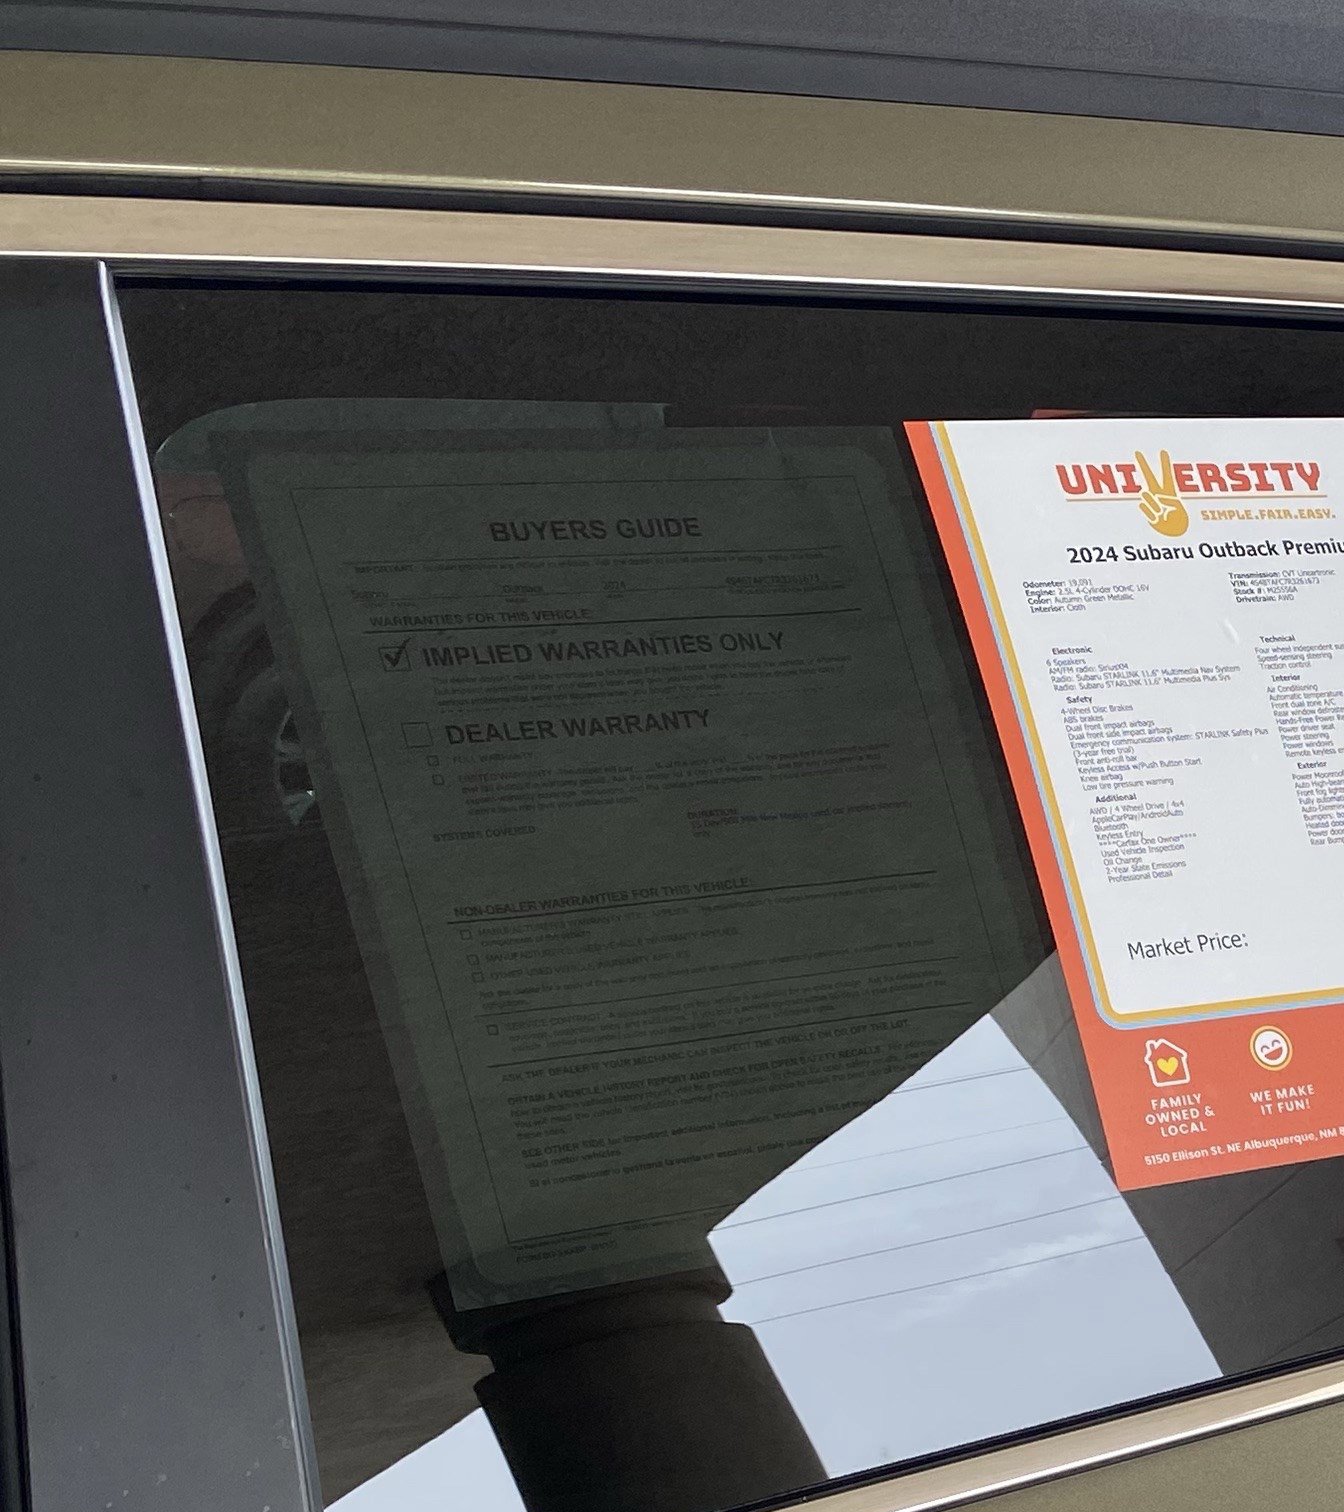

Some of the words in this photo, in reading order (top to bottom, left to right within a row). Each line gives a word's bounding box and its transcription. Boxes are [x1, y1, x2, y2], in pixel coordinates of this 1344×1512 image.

[489, 520, 607, 543] BUYERS
[616, 516, 702, 539] GUIDE
[1065, 546, 1119, 563] 2024
[1121, 543, 1194, 561] Subaru
[1196, 540, 1279, 558] Outback
[369, 613, 463, 628] WARRANTIES
[466, 612, 496, 624] FOR
[500, 610, 530, 623] THIS
[423, 643, 533, 668] IMPLIED
[538, 635, 712, 663] WARRANTIES
[720, 631, 785, 653] ONLY
[446, 719, 557, 745] DEALER
[562, 709, 709, 739] WARRANTY
[1126, 936, 1193, 960] Market
[1196, 929, 1249, 952] Price:
[1150, 1092, 1203, 1111] FAMILY
[1249, 1089, 1272, 1103] WE
[1275, 1083, 1315, 1099] MAKE
[1144, 1107, 1200, 1126] OWNED
[1202, 1105, 1215, 1117] &
[1259, 1103, 1275, 1115] IT
[1276, 1098, 1311, 1113] FUN!
[1159, 1120, 1207, 1138] LOCAL
[1143, 1152, 1171, 1166] 5150
[1170, 1146, 1209, 1162] Ellison
[1225, 1141, 1242, 1153] NE
[1241, 1129, 1318, 1153] Albuquerque,
[1317, 1127, 1337, 1140] NM
